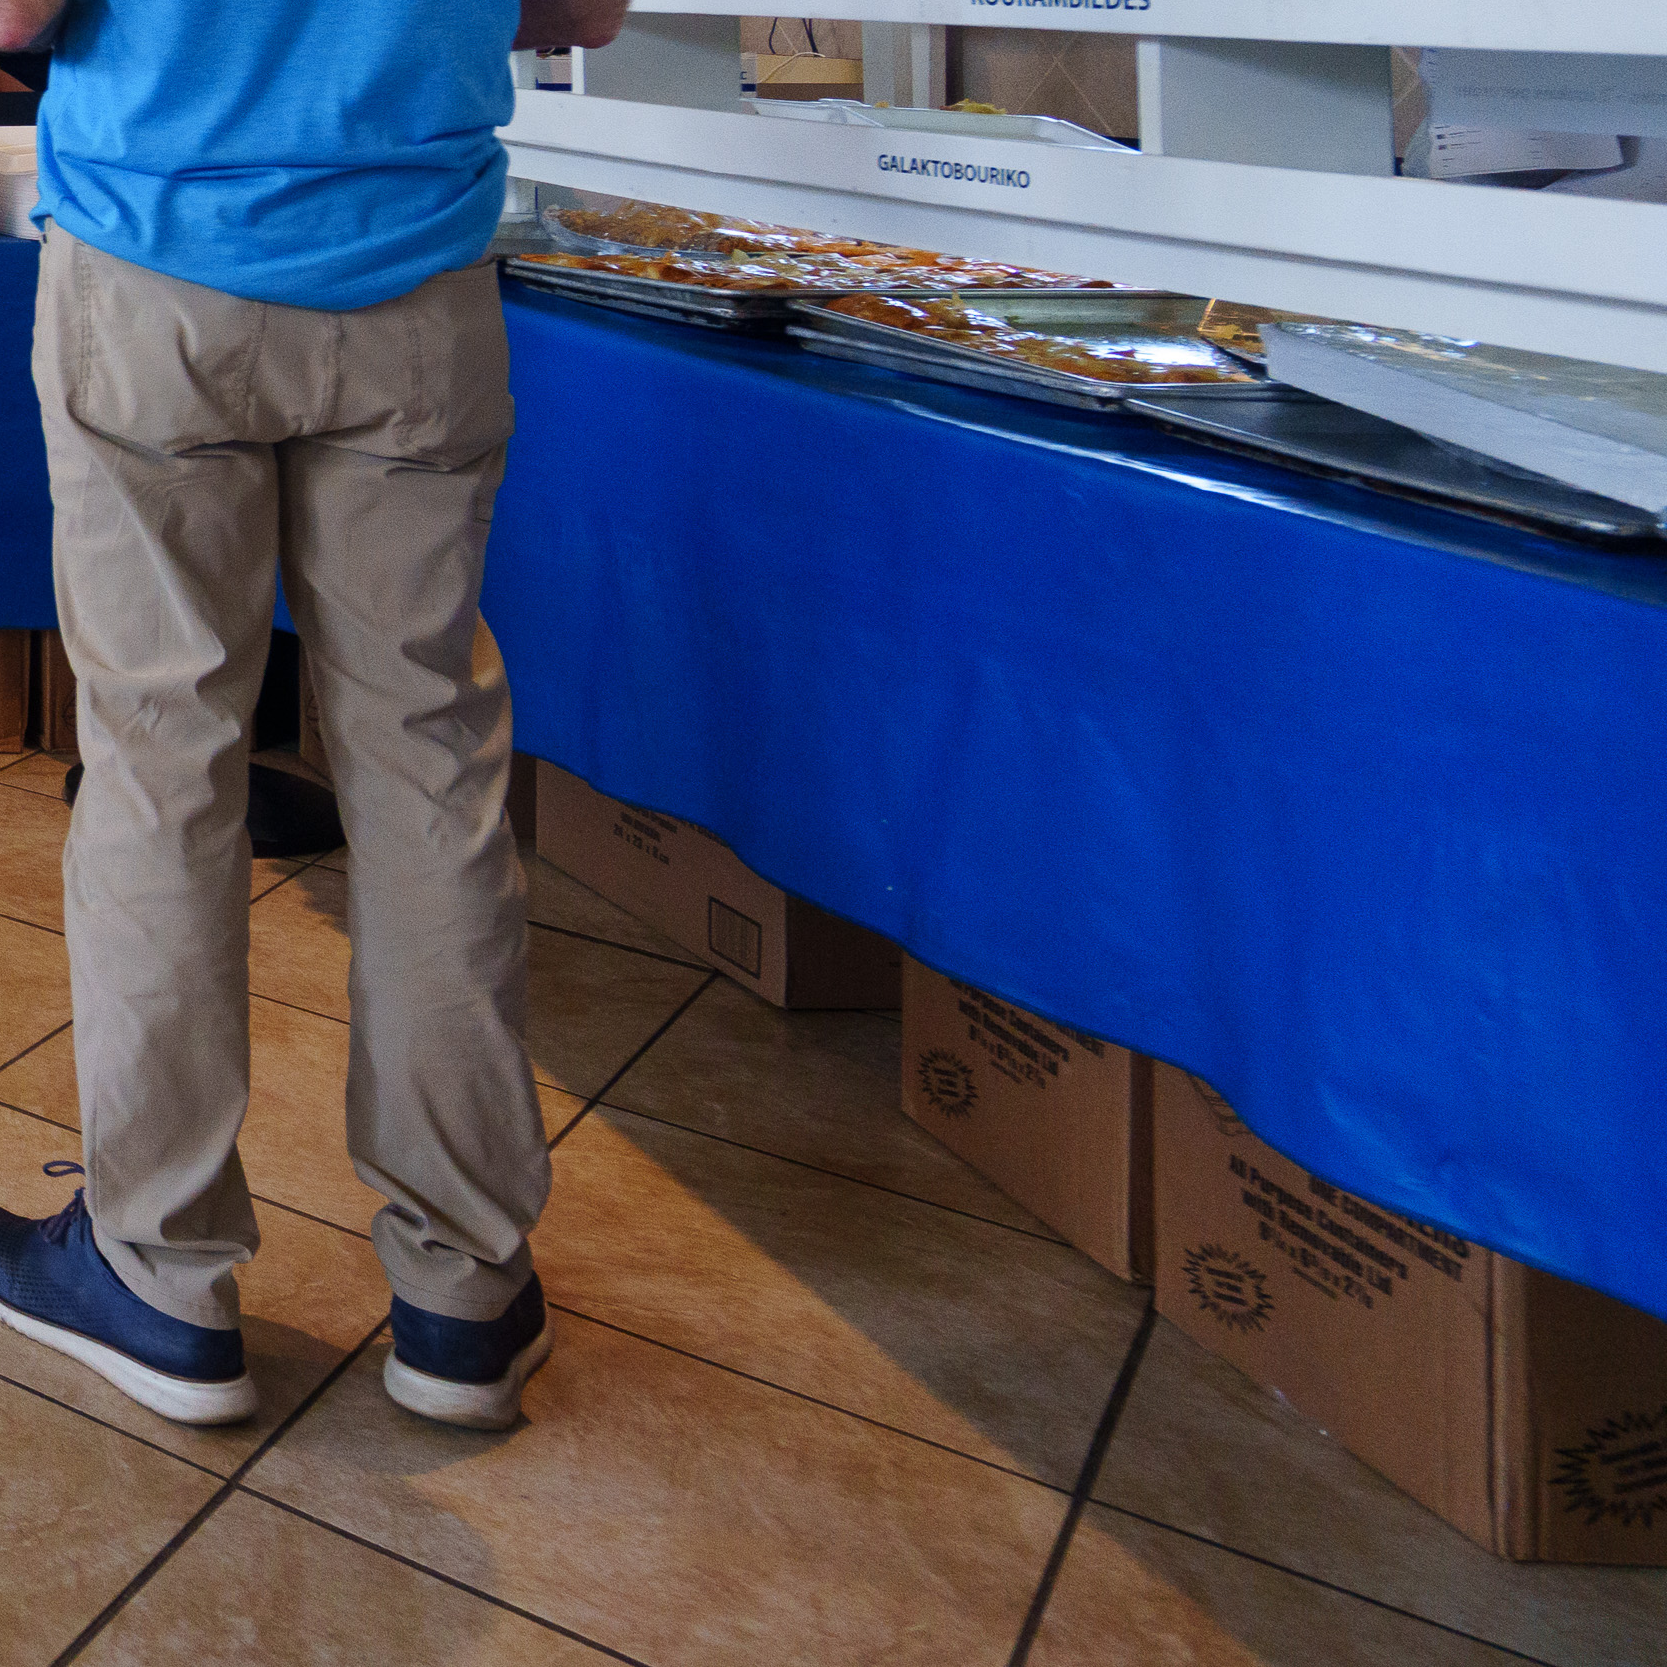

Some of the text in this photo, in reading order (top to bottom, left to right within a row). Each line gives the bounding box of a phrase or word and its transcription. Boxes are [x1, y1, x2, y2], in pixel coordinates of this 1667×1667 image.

[878, 154, 1031, 189] GALAKTOBOURIKO
[1242, 1187, 1275, 1221] with
[1278, 1209, 1363, 1277] Removable
[1250, 1166, 1313, 1221] Purpose
[1318, 1209, 1408, 1279] Containers
